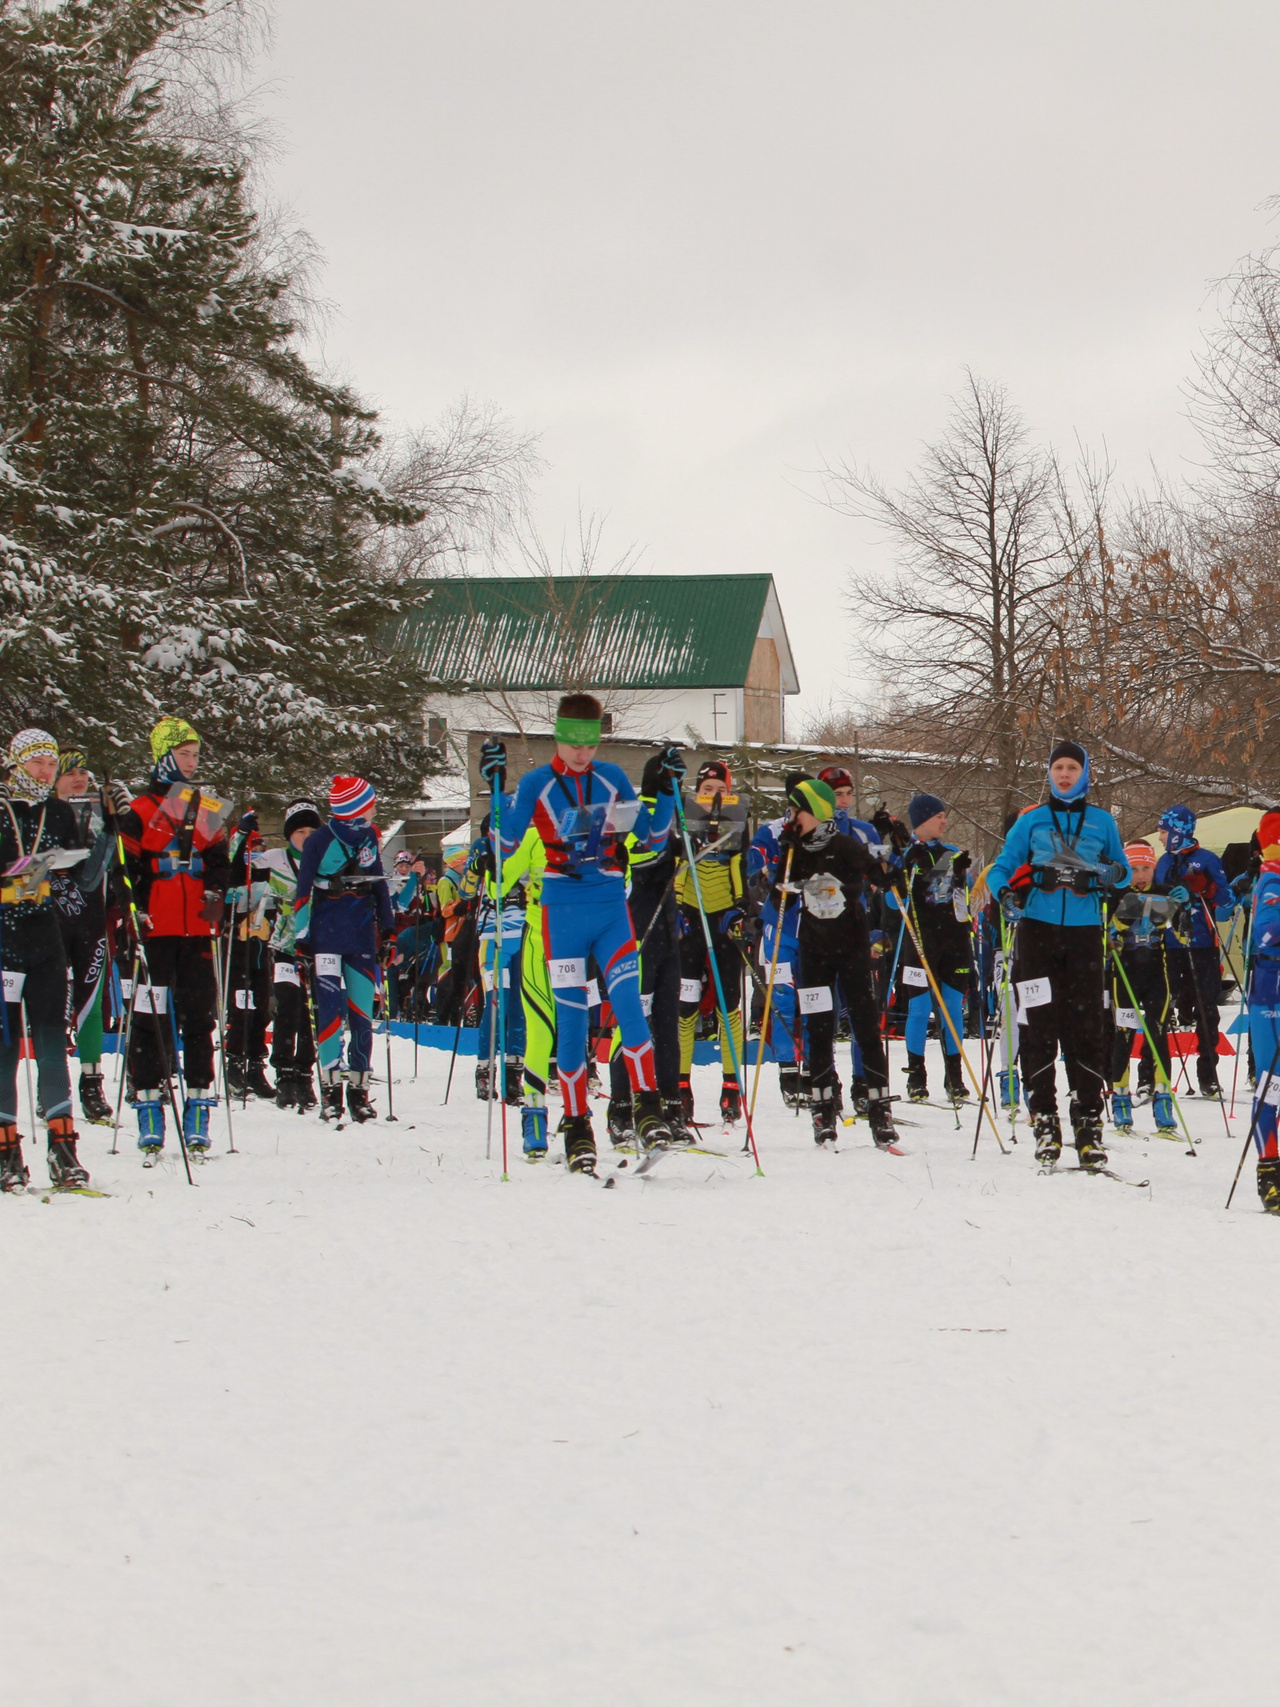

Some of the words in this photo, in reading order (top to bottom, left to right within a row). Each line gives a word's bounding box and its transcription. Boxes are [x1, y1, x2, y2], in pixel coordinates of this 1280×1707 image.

[558, 964, 576, 973] 708
[3, 979, 14, 987] 09
[1025, 985, 1039, 994] 717
[145, 991, 160, 1001] 79
[806, 993, 819, 1001] 727
